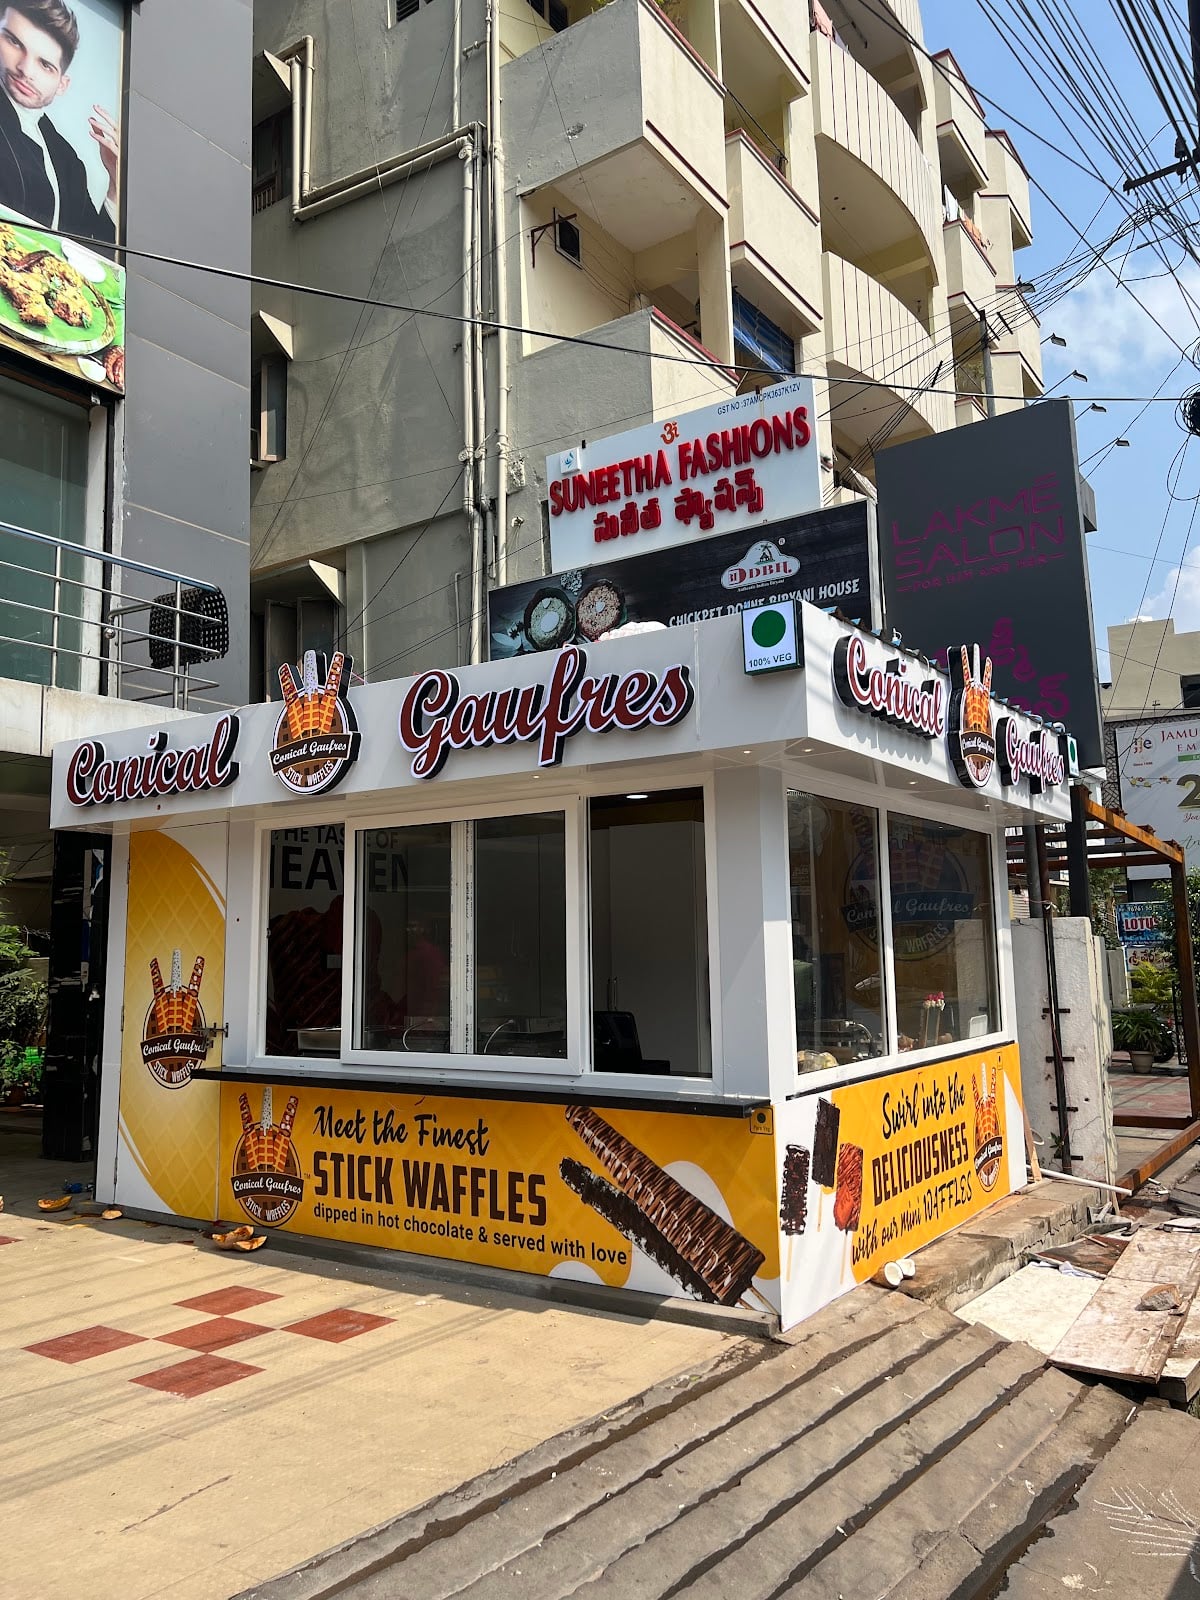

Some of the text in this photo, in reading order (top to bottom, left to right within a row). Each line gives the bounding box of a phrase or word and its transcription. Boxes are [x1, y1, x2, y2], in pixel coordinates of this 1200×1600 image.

[717, 405, 730, 416] GST
[730, 401, 740, 410] NO
[549, 406, 811, 517] SUNEETHA FASHIONS
[895, 515, 1065, 580] SALON
[818, 578, 860, 599] HOUSE
[748, 652, 793, 667] 100% VEG
[66, 644, 693, 807] Conical Gaufres
[846, 635, 944, 738] Conical
[1006, 716, 1065, 793] Gaufres
[273, 739, 347, 765] Conical Gaufres
[285, 760, 334, 786] STICK WAFFLES
[376, 831, 399, 849] OF
[143, 1039, 172, 1056] Conical
[153, 1060, 168, 1081] STICK
[882, 1071, 966, 1140] Swirl into the
[312, 1105, 490, 1156] Meet the Finest
[871, 1121, 970, 1208] DELICIOUSNESS
[233, 1177, 302, 1195] Conical Gaufres
[313, 1151, 547, 1227] STICK WAFFLES
[245, 1198, 291, 1223] STICK WAFFLES
[852, 1218, 880, 1266] with
[881, 1216, 899, 1247] our
[923, 1170, 973, 1224] WAFFLES
[313, 1202, 627, 1265] dipped in hot chocolate & served with love
